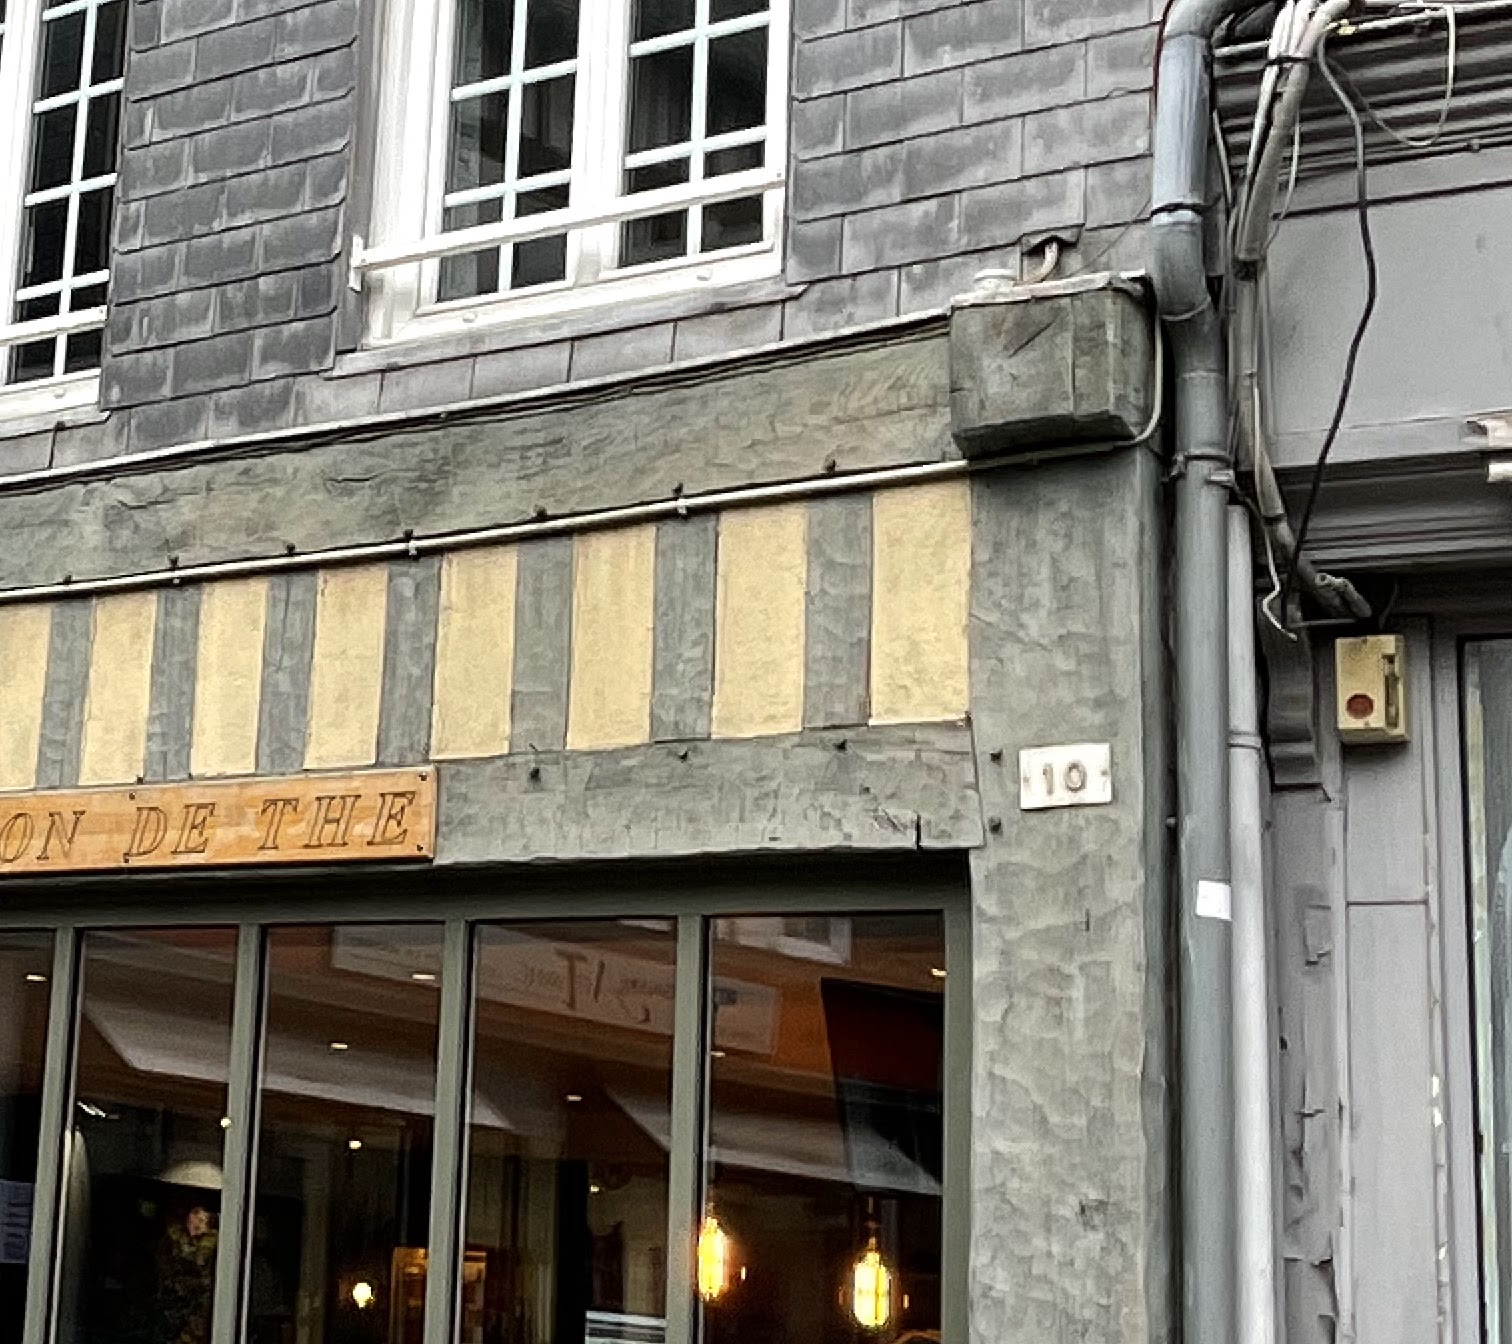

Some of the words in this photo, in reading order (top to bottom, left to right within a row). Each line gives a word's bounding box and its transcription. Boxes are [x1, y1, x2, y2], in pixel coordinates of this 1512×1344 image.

[1042, 761, 1086, 796] 10
[123, 803, 216, 858] DE
[256, 790, 417, 850] THE
